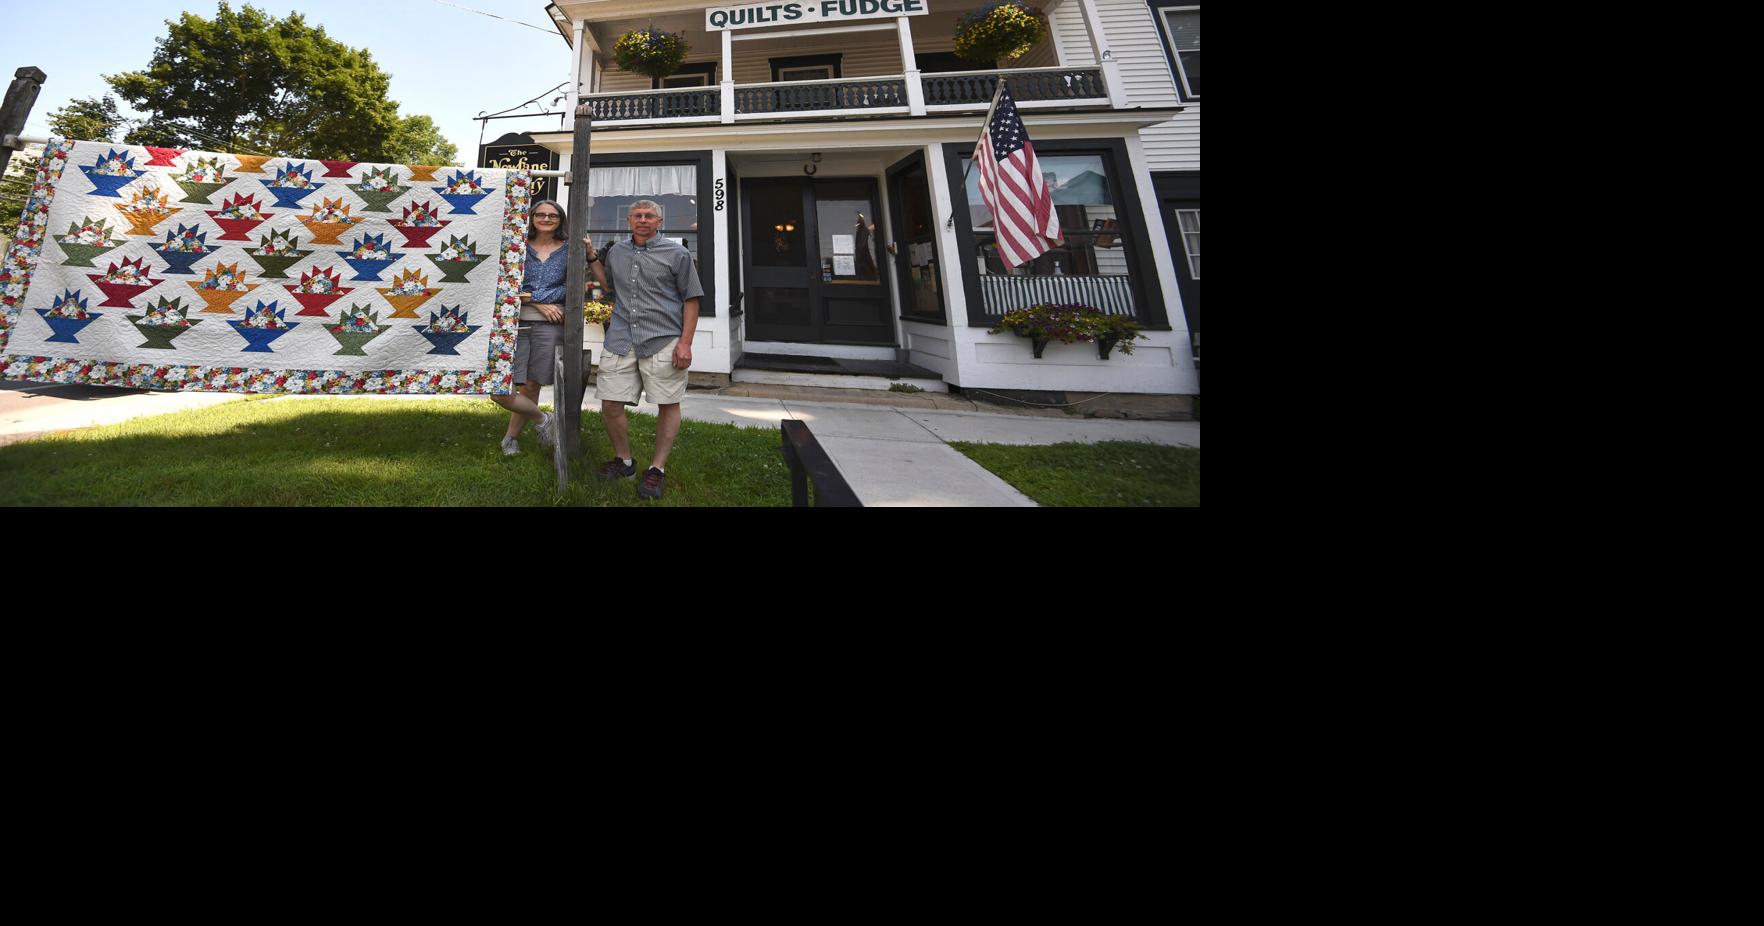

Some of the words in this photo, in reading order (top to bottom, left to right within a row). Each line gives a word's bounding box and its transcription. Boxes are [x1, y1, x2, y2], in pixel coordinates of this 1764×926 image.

[709, 3, 803, 28] QUILTS
[821, 0, 914, 17] FUDGE
[508, 149, 527, 157] The
[715, 178, 724, 211] 598
